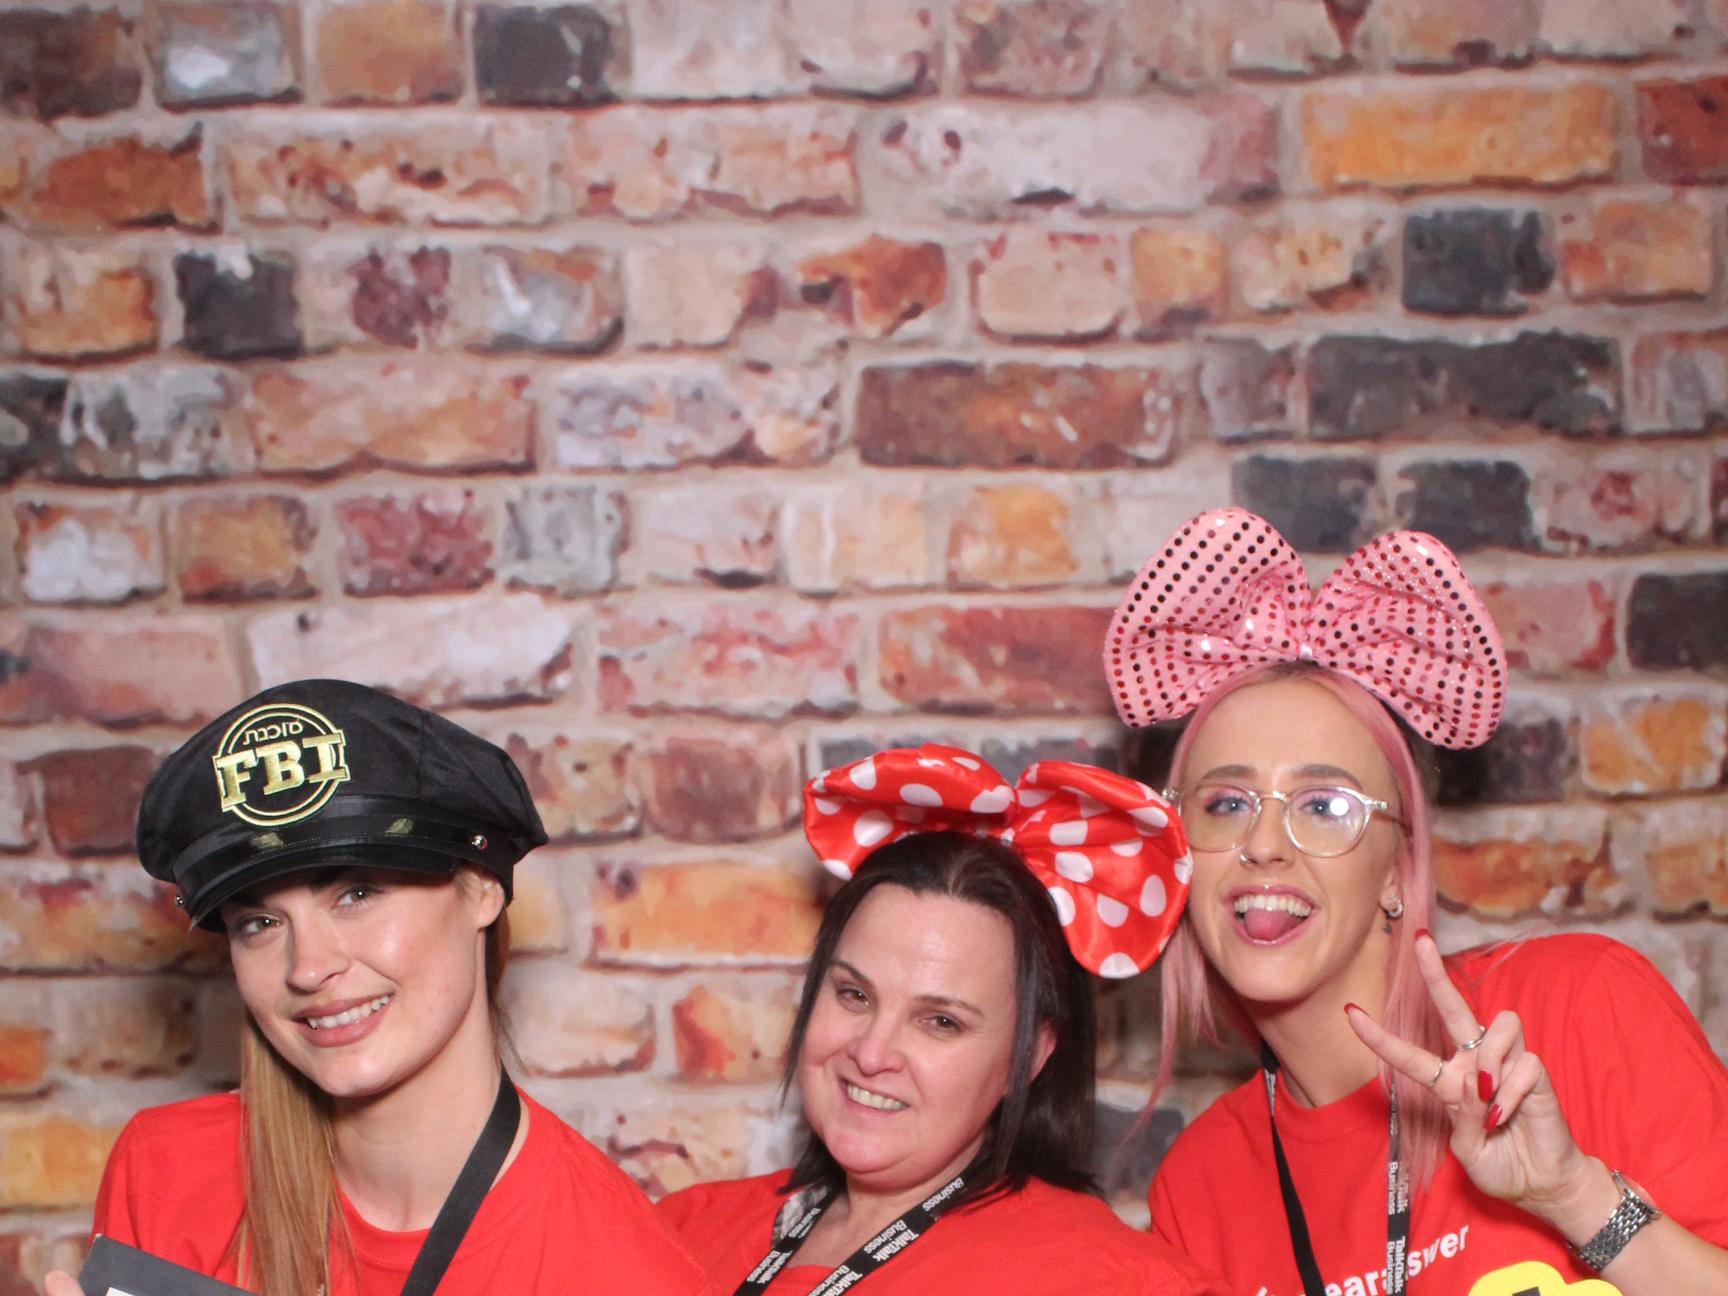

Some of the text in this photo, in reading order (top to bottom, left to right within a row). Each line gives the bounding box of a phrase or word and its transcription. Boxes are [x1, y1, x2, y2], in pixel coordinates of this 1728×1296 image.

[213, 730, 350, 812] FBI
[921, 1177, 965, 1211] Business
[863, 1219, 908, 1254] Business
[872, 1229, 919, 1262] TalkTalk
[746, 1250, 782, 1282] Business
[756, 1249, 794, 1284] TalkTalk
[1385, 1241, 1396, 1296] Business
[1393, 1236, 1406, 1294] TalkTalk
